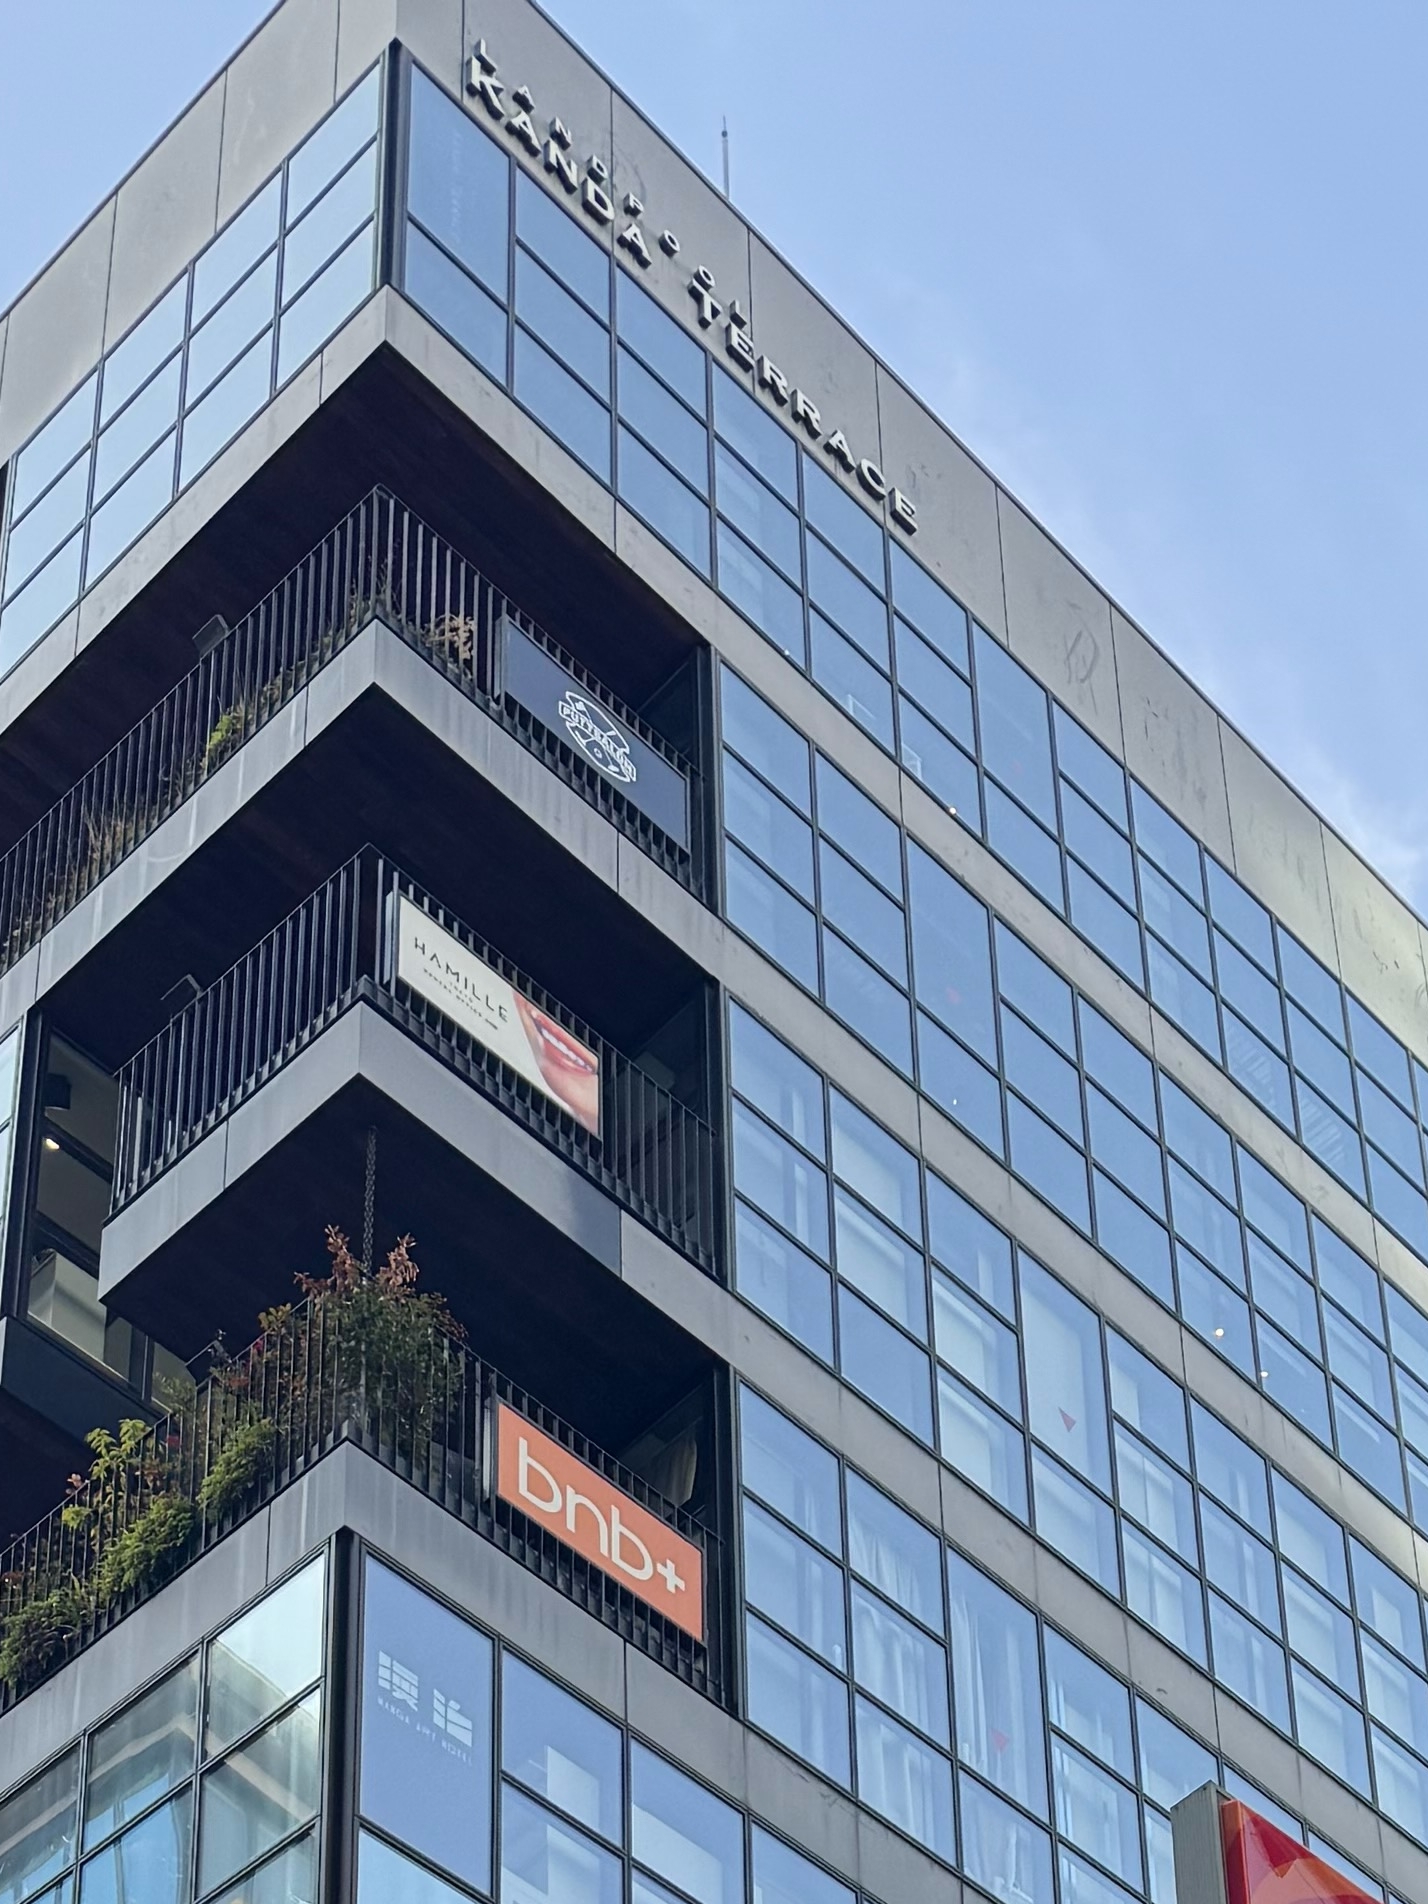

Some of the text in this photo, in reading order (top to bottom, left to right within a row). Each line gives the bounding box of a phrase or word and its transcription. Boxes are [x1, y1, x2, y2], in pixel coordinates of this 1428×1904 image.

[466, 55, 919, 536] KANDA TERRACE
[415, 937, 508, 1023] HAMILLE
